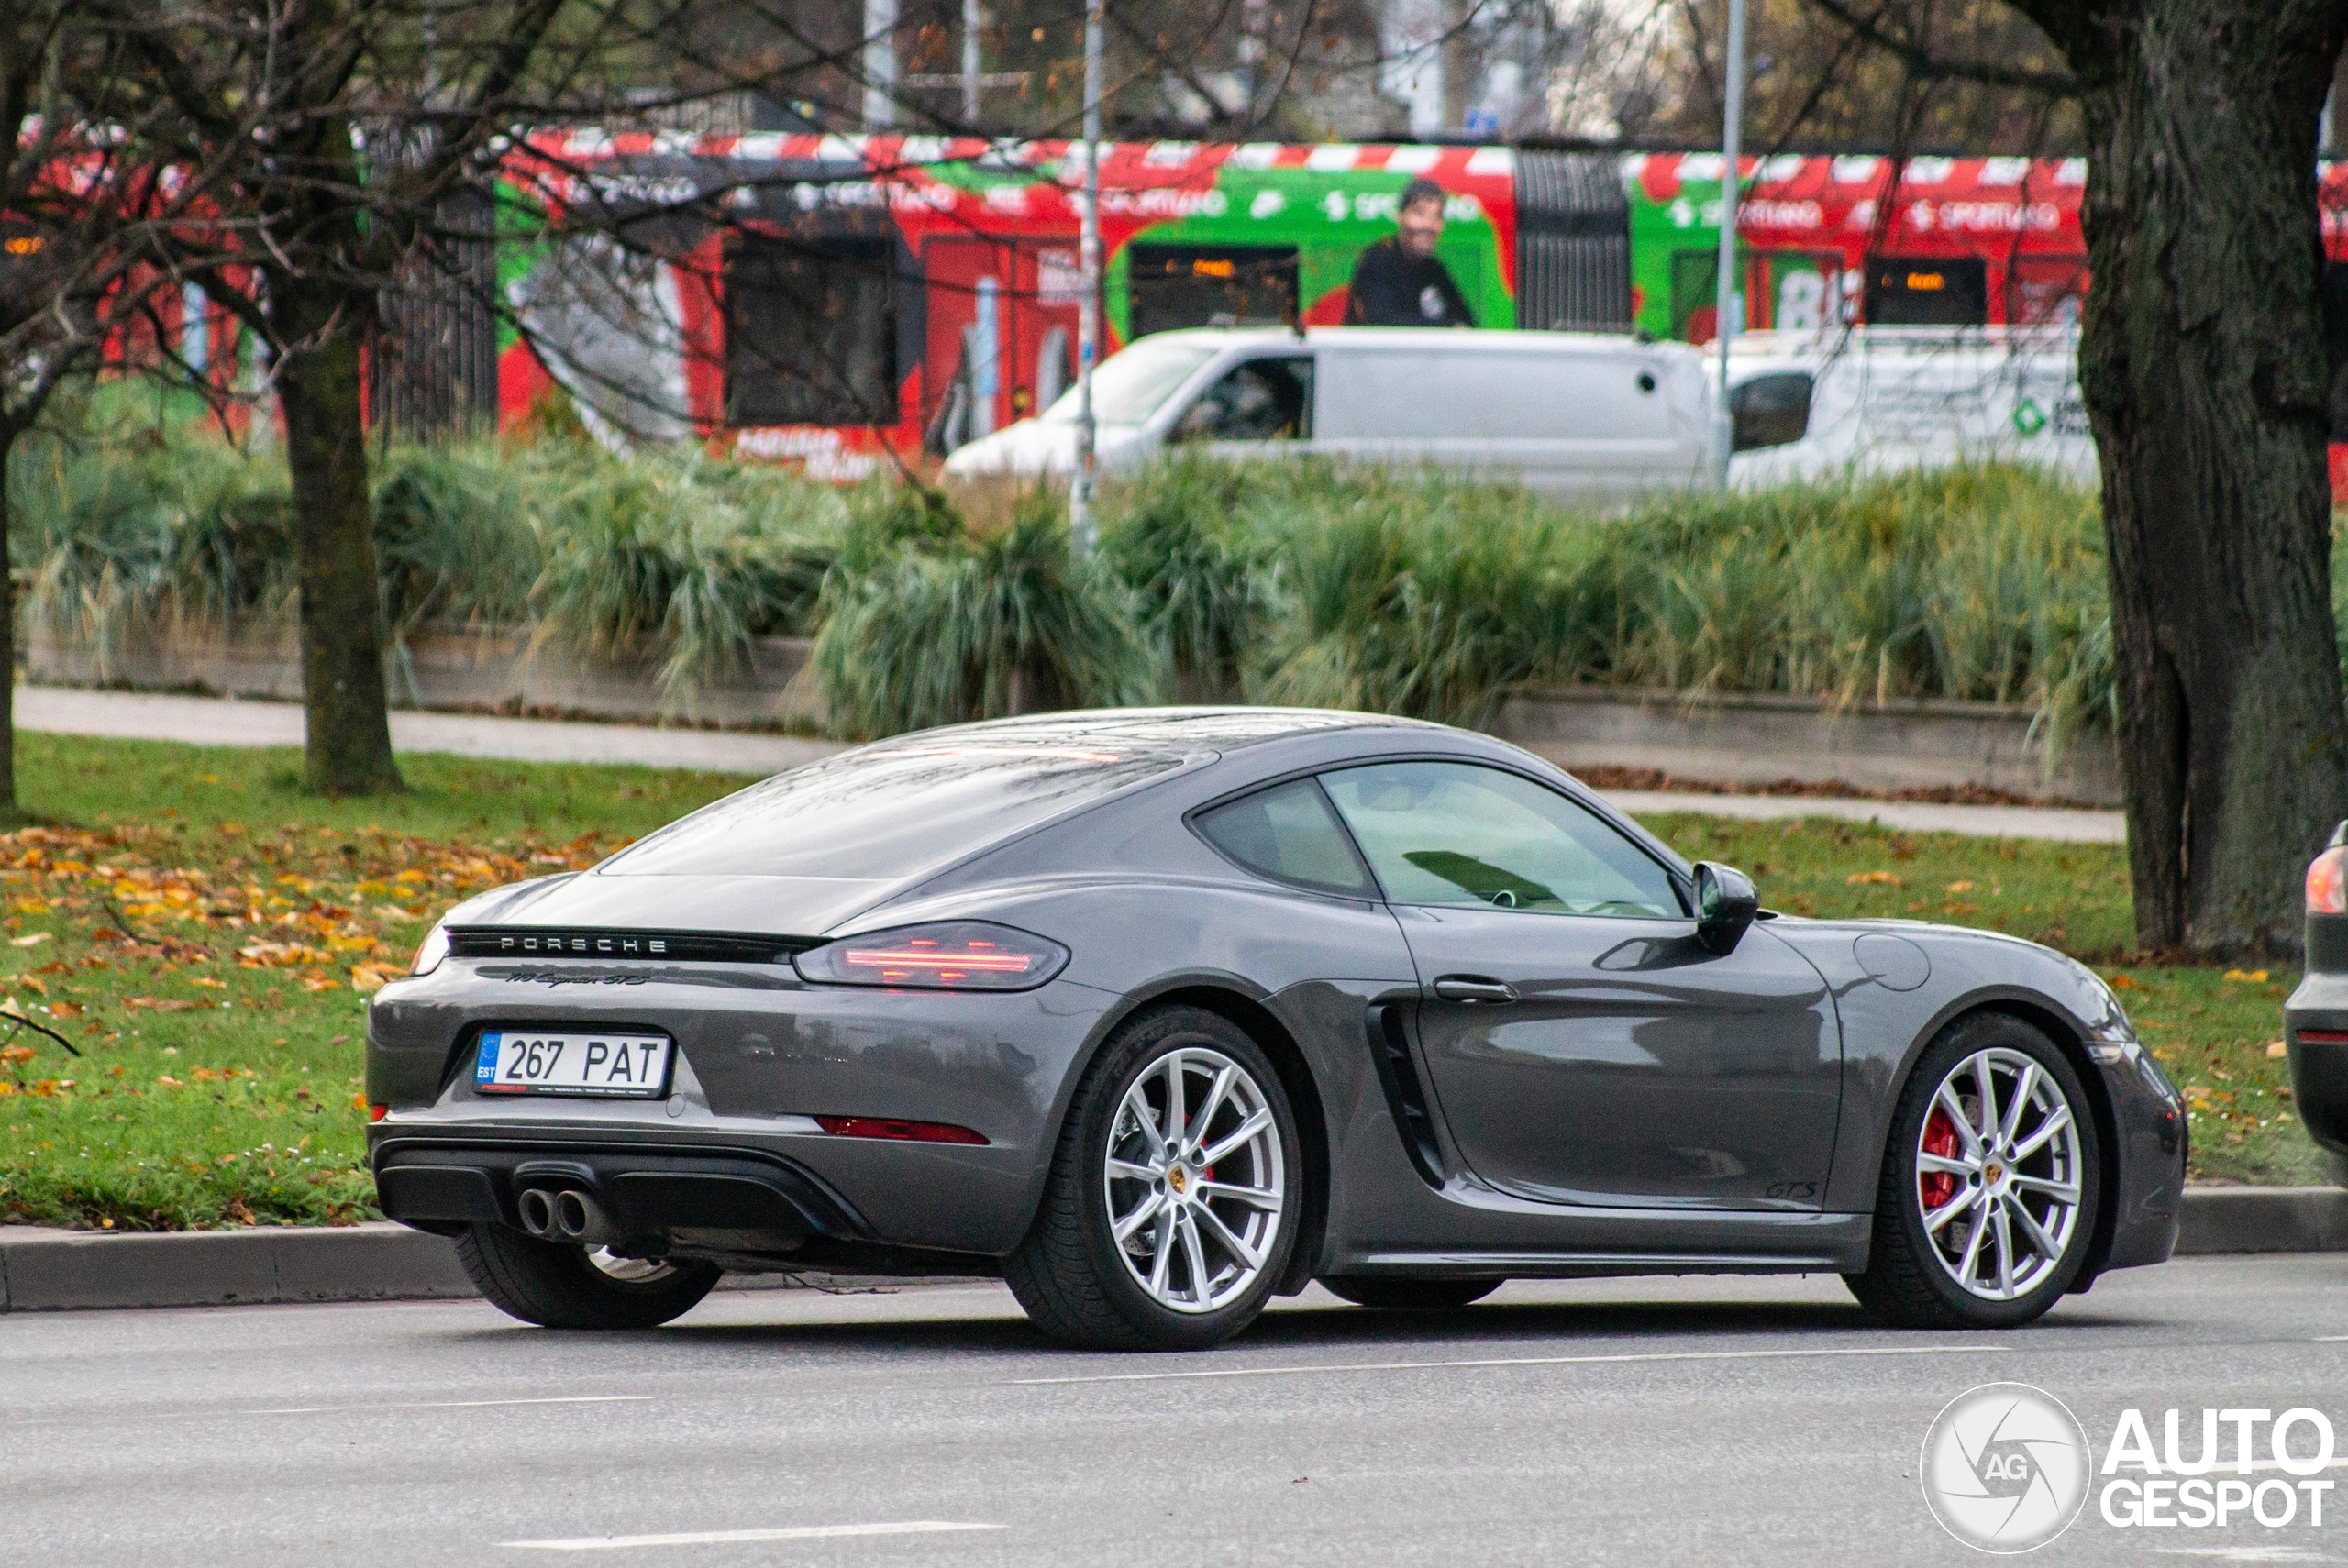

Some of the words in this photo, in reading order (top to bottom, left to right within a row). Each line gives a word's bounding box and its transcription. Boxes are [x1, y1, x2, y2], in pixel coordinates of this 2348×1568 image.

[501, 937, 667, 953] PORSCHE
[602, 975, 651, 986] GTS
[505, 1039, 565, 1080] 267
[582, 1041, 659, 1083] PAT
[477, 1066, 495, 1078] EST
[1766, 1181, 1818, 1198] GTS
